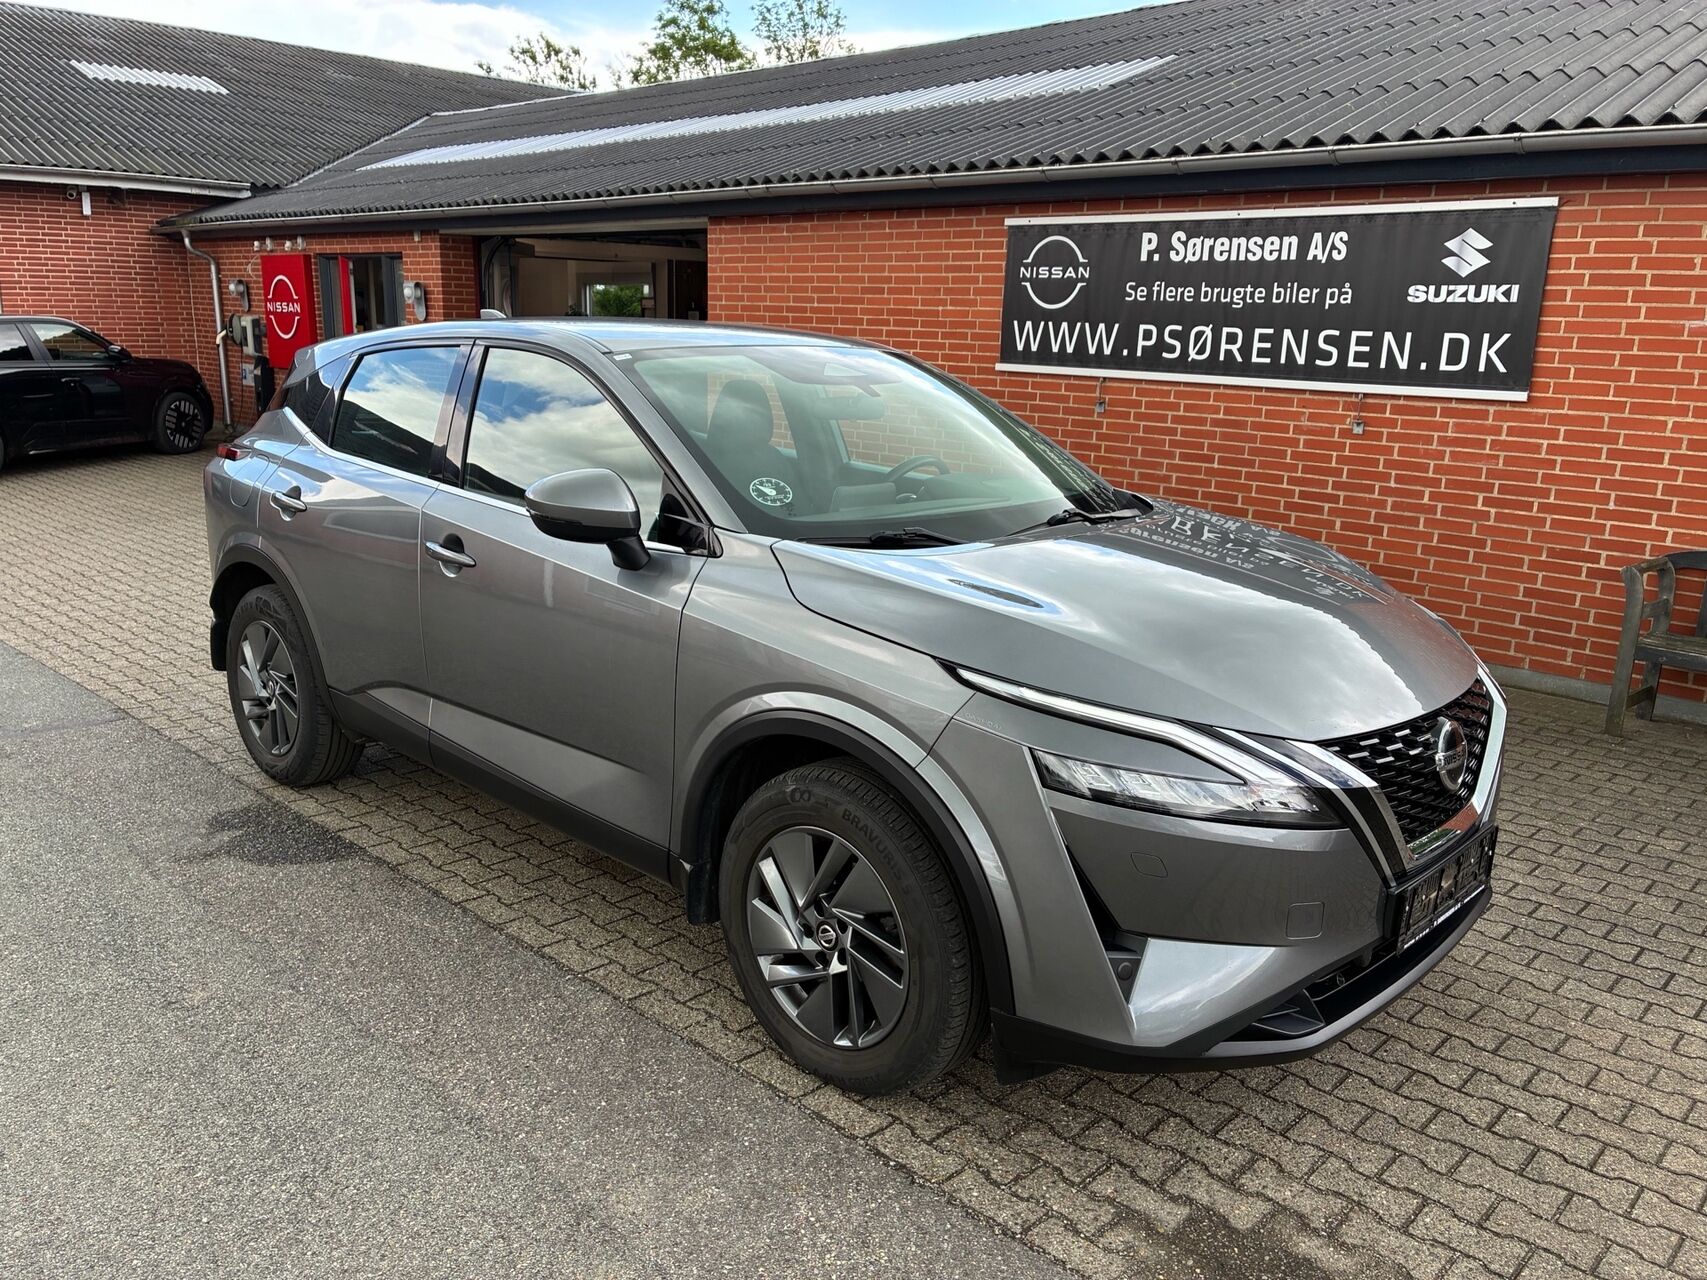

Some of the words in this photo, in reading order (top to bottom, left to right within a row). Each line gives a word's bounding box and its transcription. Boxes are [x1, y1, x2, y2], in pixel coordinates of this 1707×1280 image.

[1140, 232, 1160, 262] P.
[1169, 231, 1299, 264] Sørensen
[1306, 231, 1349, 264] A/S
[1019, 266, 1090, 279] NISSAN
[1125, 282, 1148, 301] Se
[1152, 281, 1195, 302] flere
[1200, 282, 1266, 308] brugte
[1272, 282, 1320, 304] biler
[1325, 282, 1353, 310] på
[1406, 284, 1520, 303] SUZUKI
[266, 301, 301, 313] NISSAN
[1013, 320, 1512, 373] WWW.PSØRENSEN.DK
